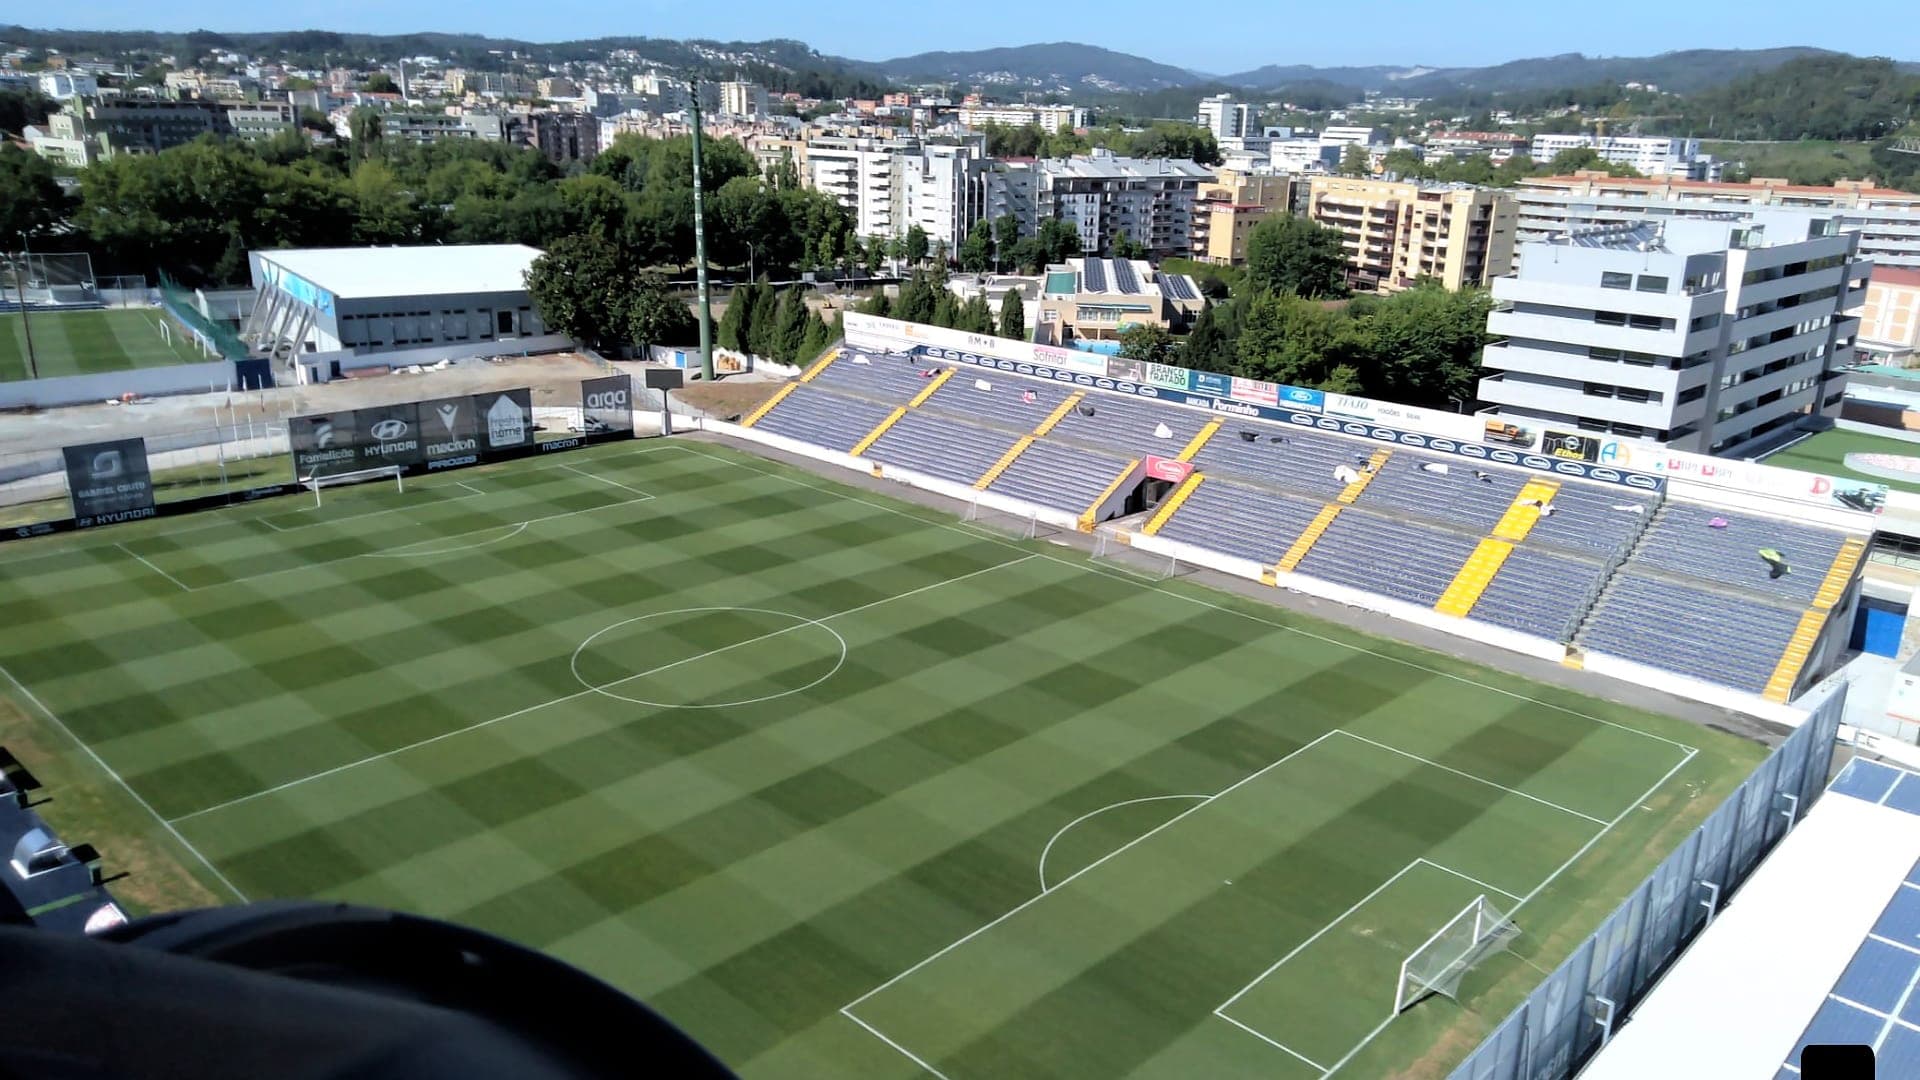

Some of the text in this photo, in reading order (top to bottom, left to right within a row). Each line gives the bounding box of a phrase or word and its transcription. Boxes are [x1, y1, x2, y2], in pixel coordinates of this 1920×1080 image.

[1150, 364, 1185, 378] BRANCO
[1150, 371, 1186, 386] TRATADO
[1212, 398, 1260, 417] Porminho
[364, 440, 417, 457] HYUNDAI
[426, 438, 476, 456] macron
[542, 438, 579, 452] macron
[96, 508, 154, 524] HYUNDAI
